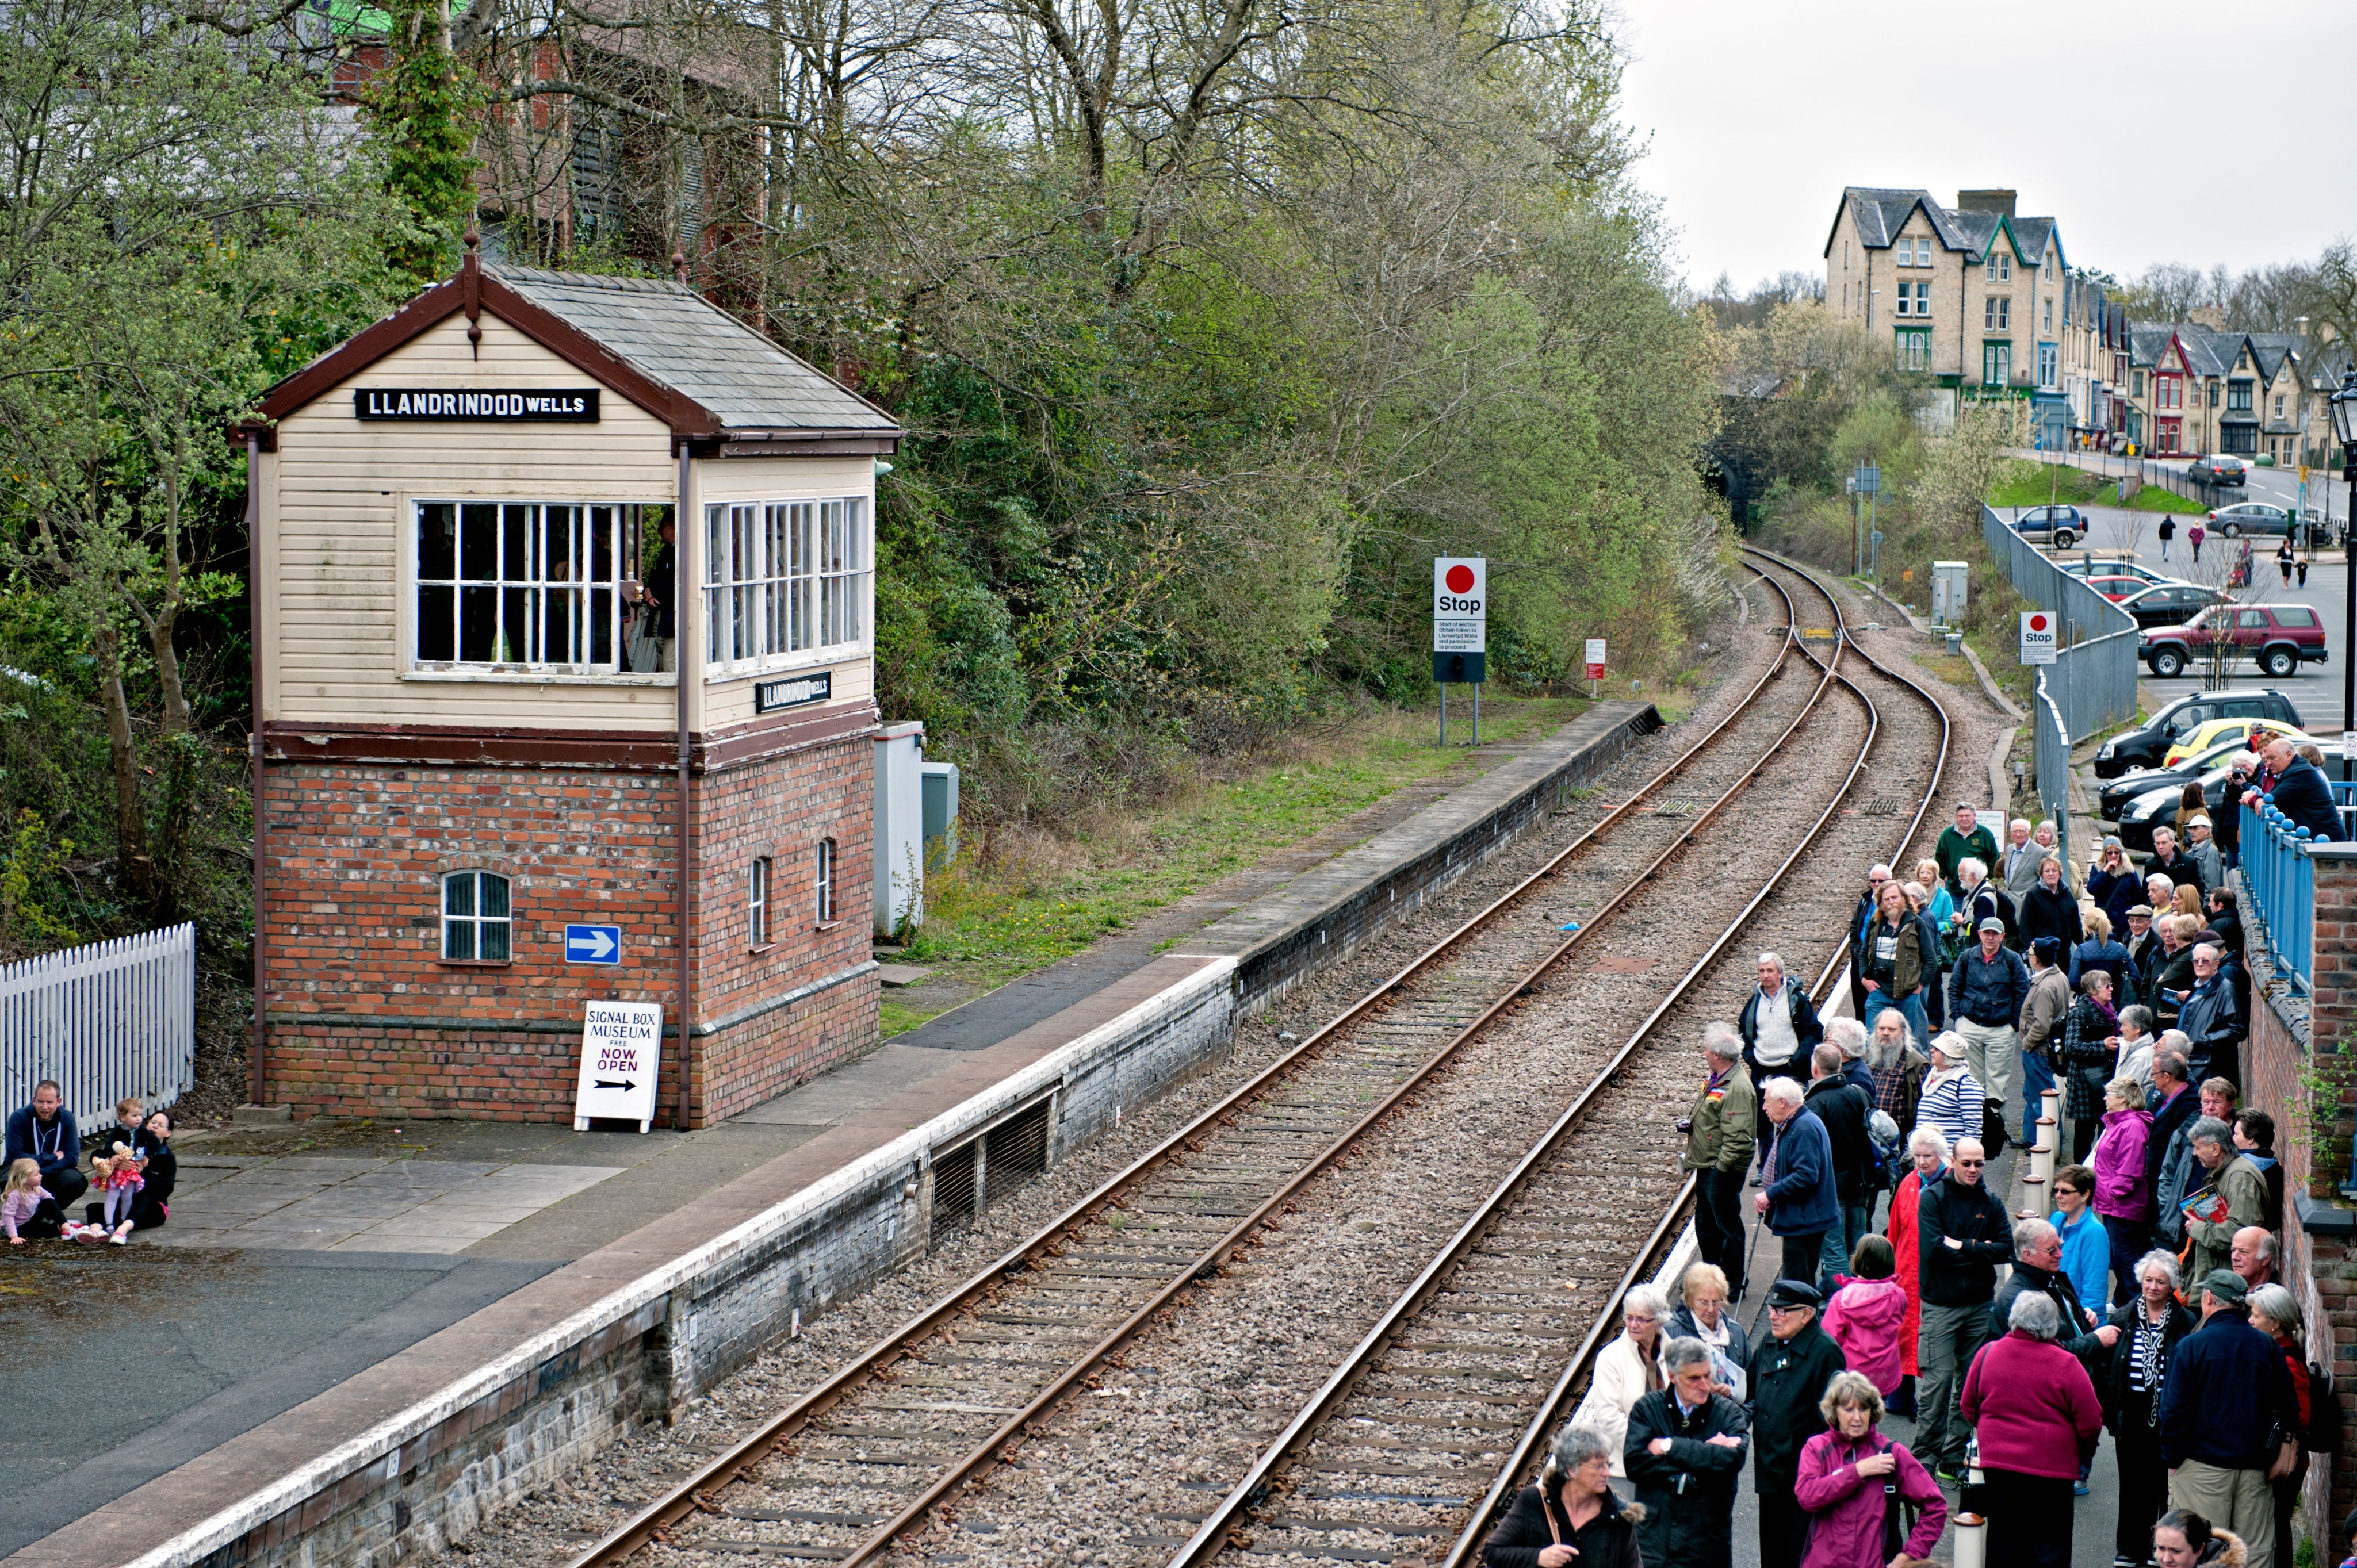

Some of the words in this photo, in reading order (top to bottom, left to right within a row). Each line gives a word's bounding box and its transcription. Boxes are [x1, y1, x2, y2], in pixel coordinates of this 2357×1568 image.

[369, 393, 523, 415] LLANDRINDOD
[526, 397, 584, 412] WELLS
[1439, 596, 1480, 615] Stop
[2026, 633, 2052, 643] Stop
[763, 680, 811, 707] LLANDRINDOD
[810, 679, 827, 695] WELLS
[588, 1011, 628, 1024] SIGNAL
[633, 1013, 655, 1025] BOX
[590, 1025, 651, 1039] MUSEUM
[601, 1048, 637, 1060] NOW
[598, 1060, 637, 1072] OPEN
